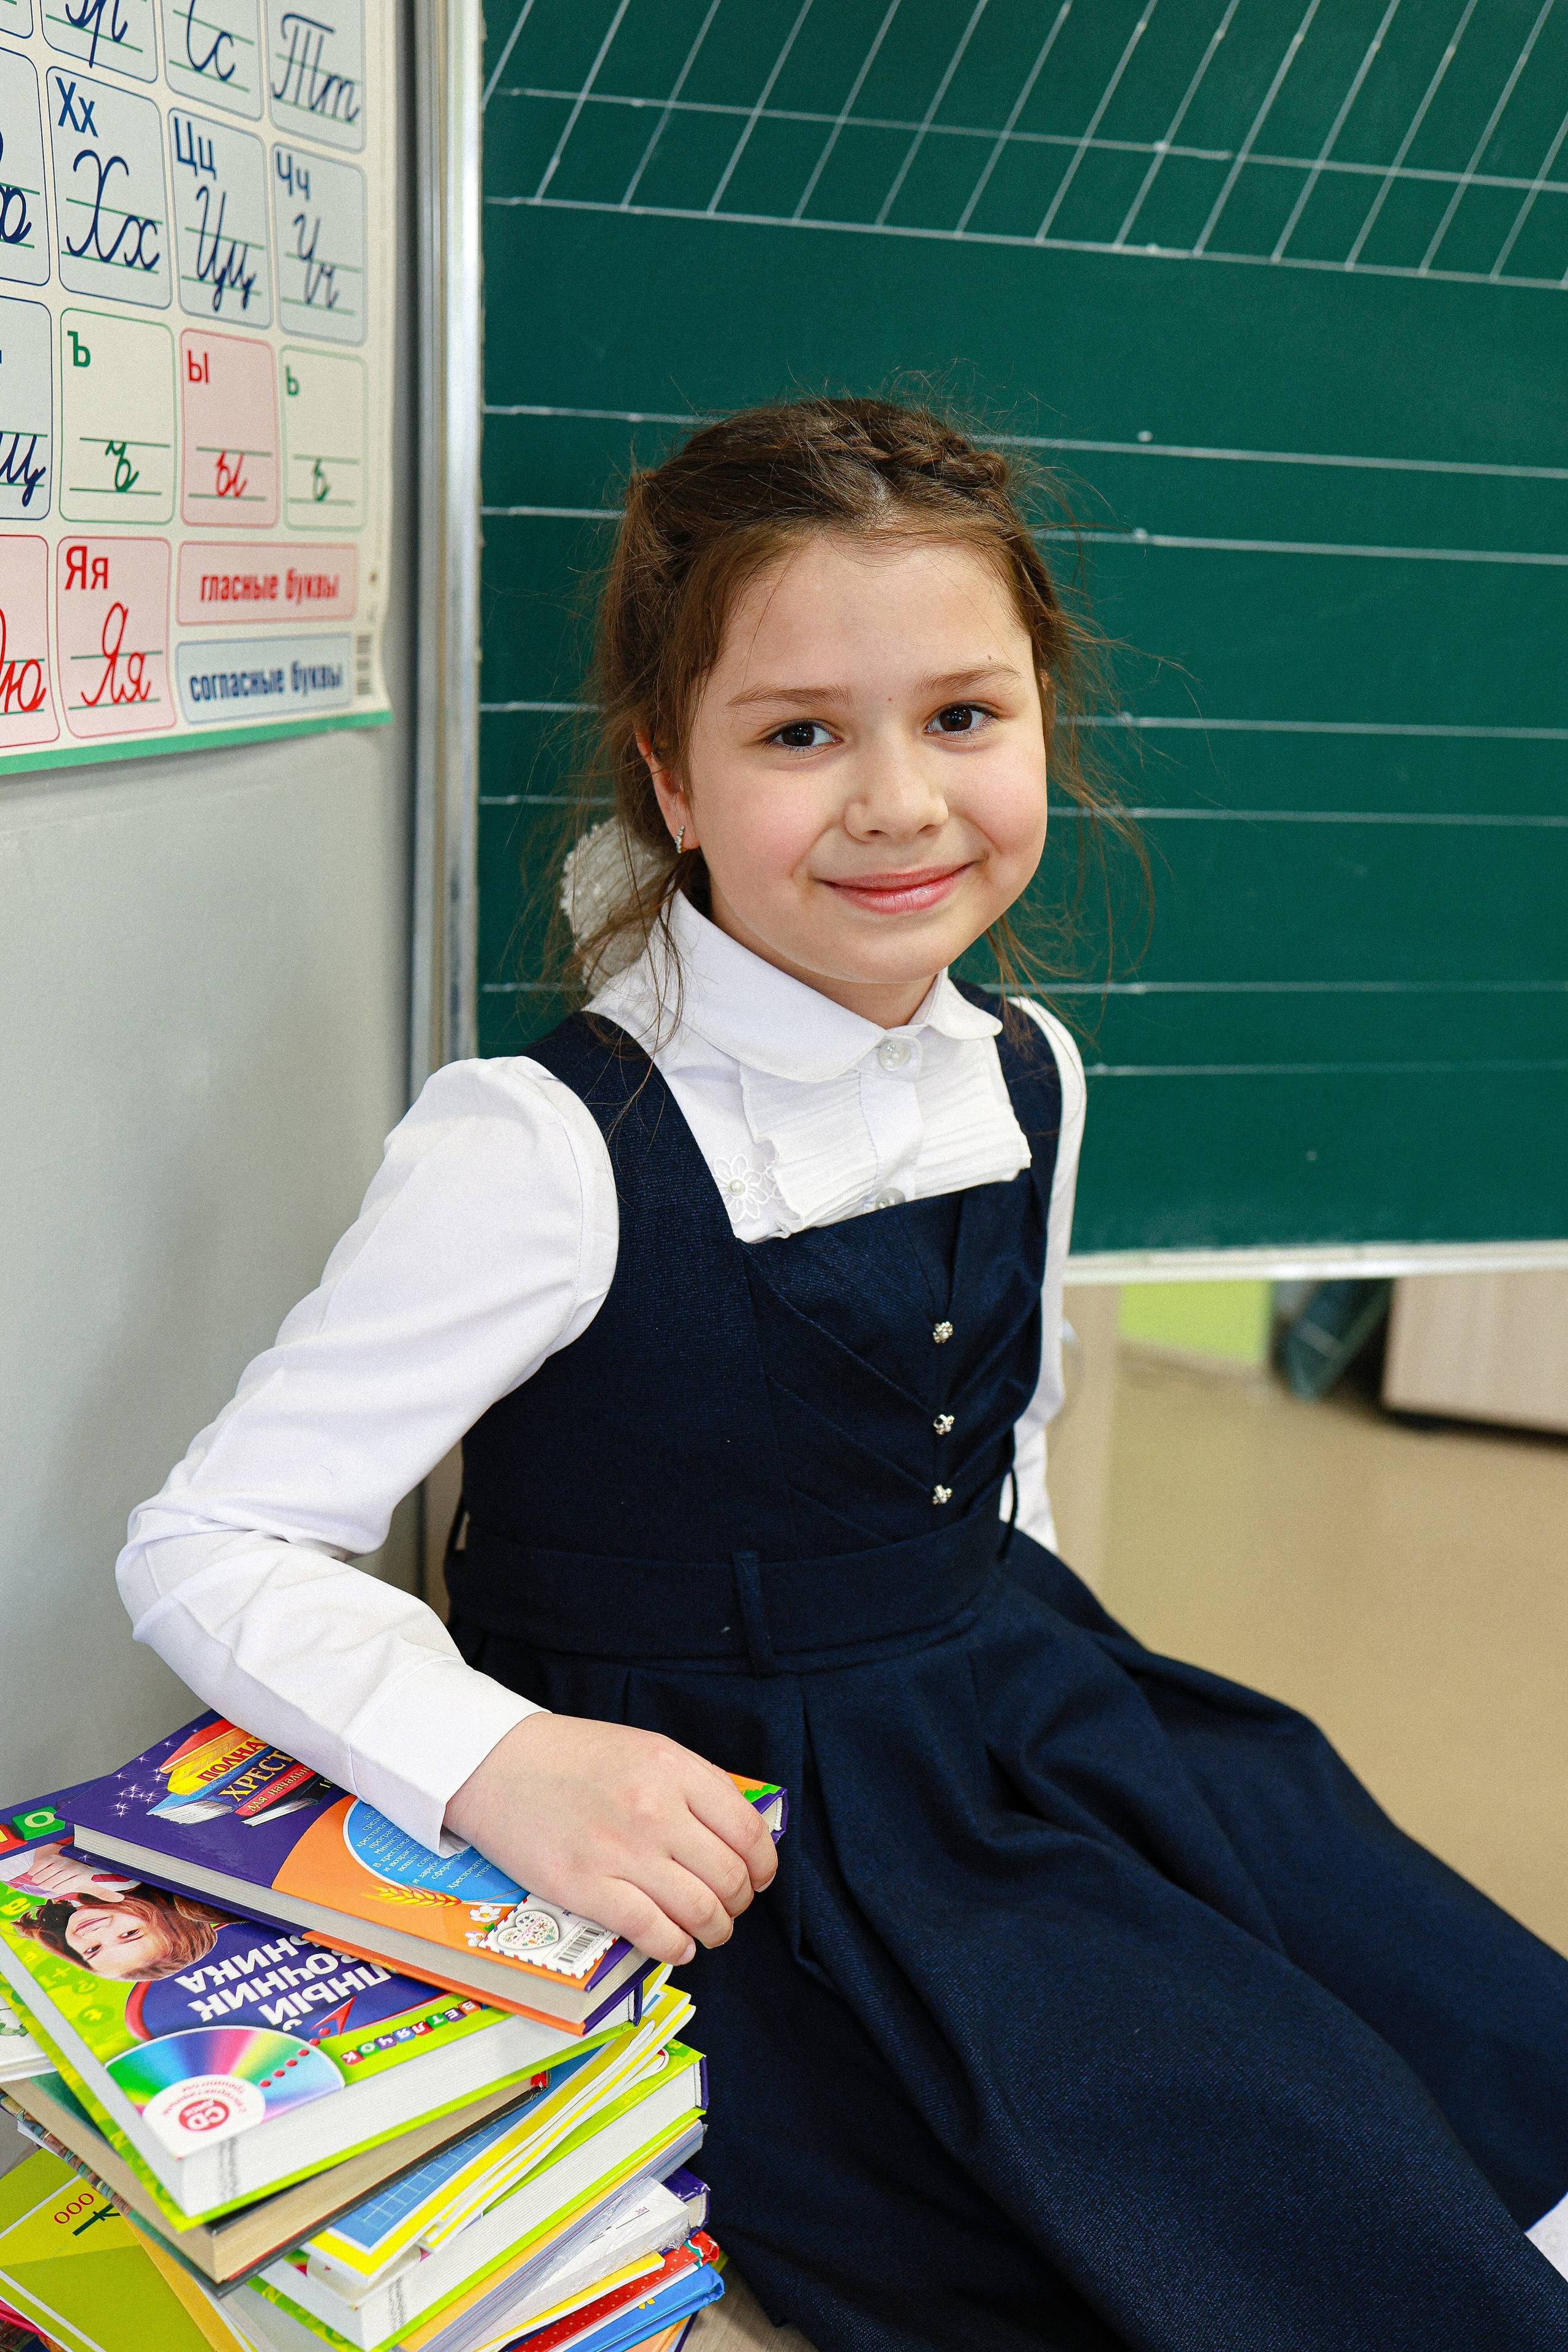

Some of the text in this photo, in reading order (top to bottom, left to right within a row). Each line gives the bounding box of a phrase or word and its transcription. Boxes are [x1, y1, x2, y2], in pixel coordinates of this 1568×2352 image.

[55, 76, 99, 138] Хх
[174, 116, 217, 181] Цц
[276, 151, 311, 202] Чч
[66, 149, 160, 270] Хх
[64, 546, 110, 590] Яя
[200, 567, 339, 605] гласные буквы
[80, 602, 151, 707] Яя
[189, 659, 343, 702] согласные буквы
[196, 1736, 268, 1782] ПОЛНА
[218, 1750, 295, 1802] ХРЕСТ
[247, 1796, 268, 1811] для
[363, 1809, 376, 1820] для
[397, 1853, 420, 1872] вошли
[186, 2105, 227, 2130] CD
